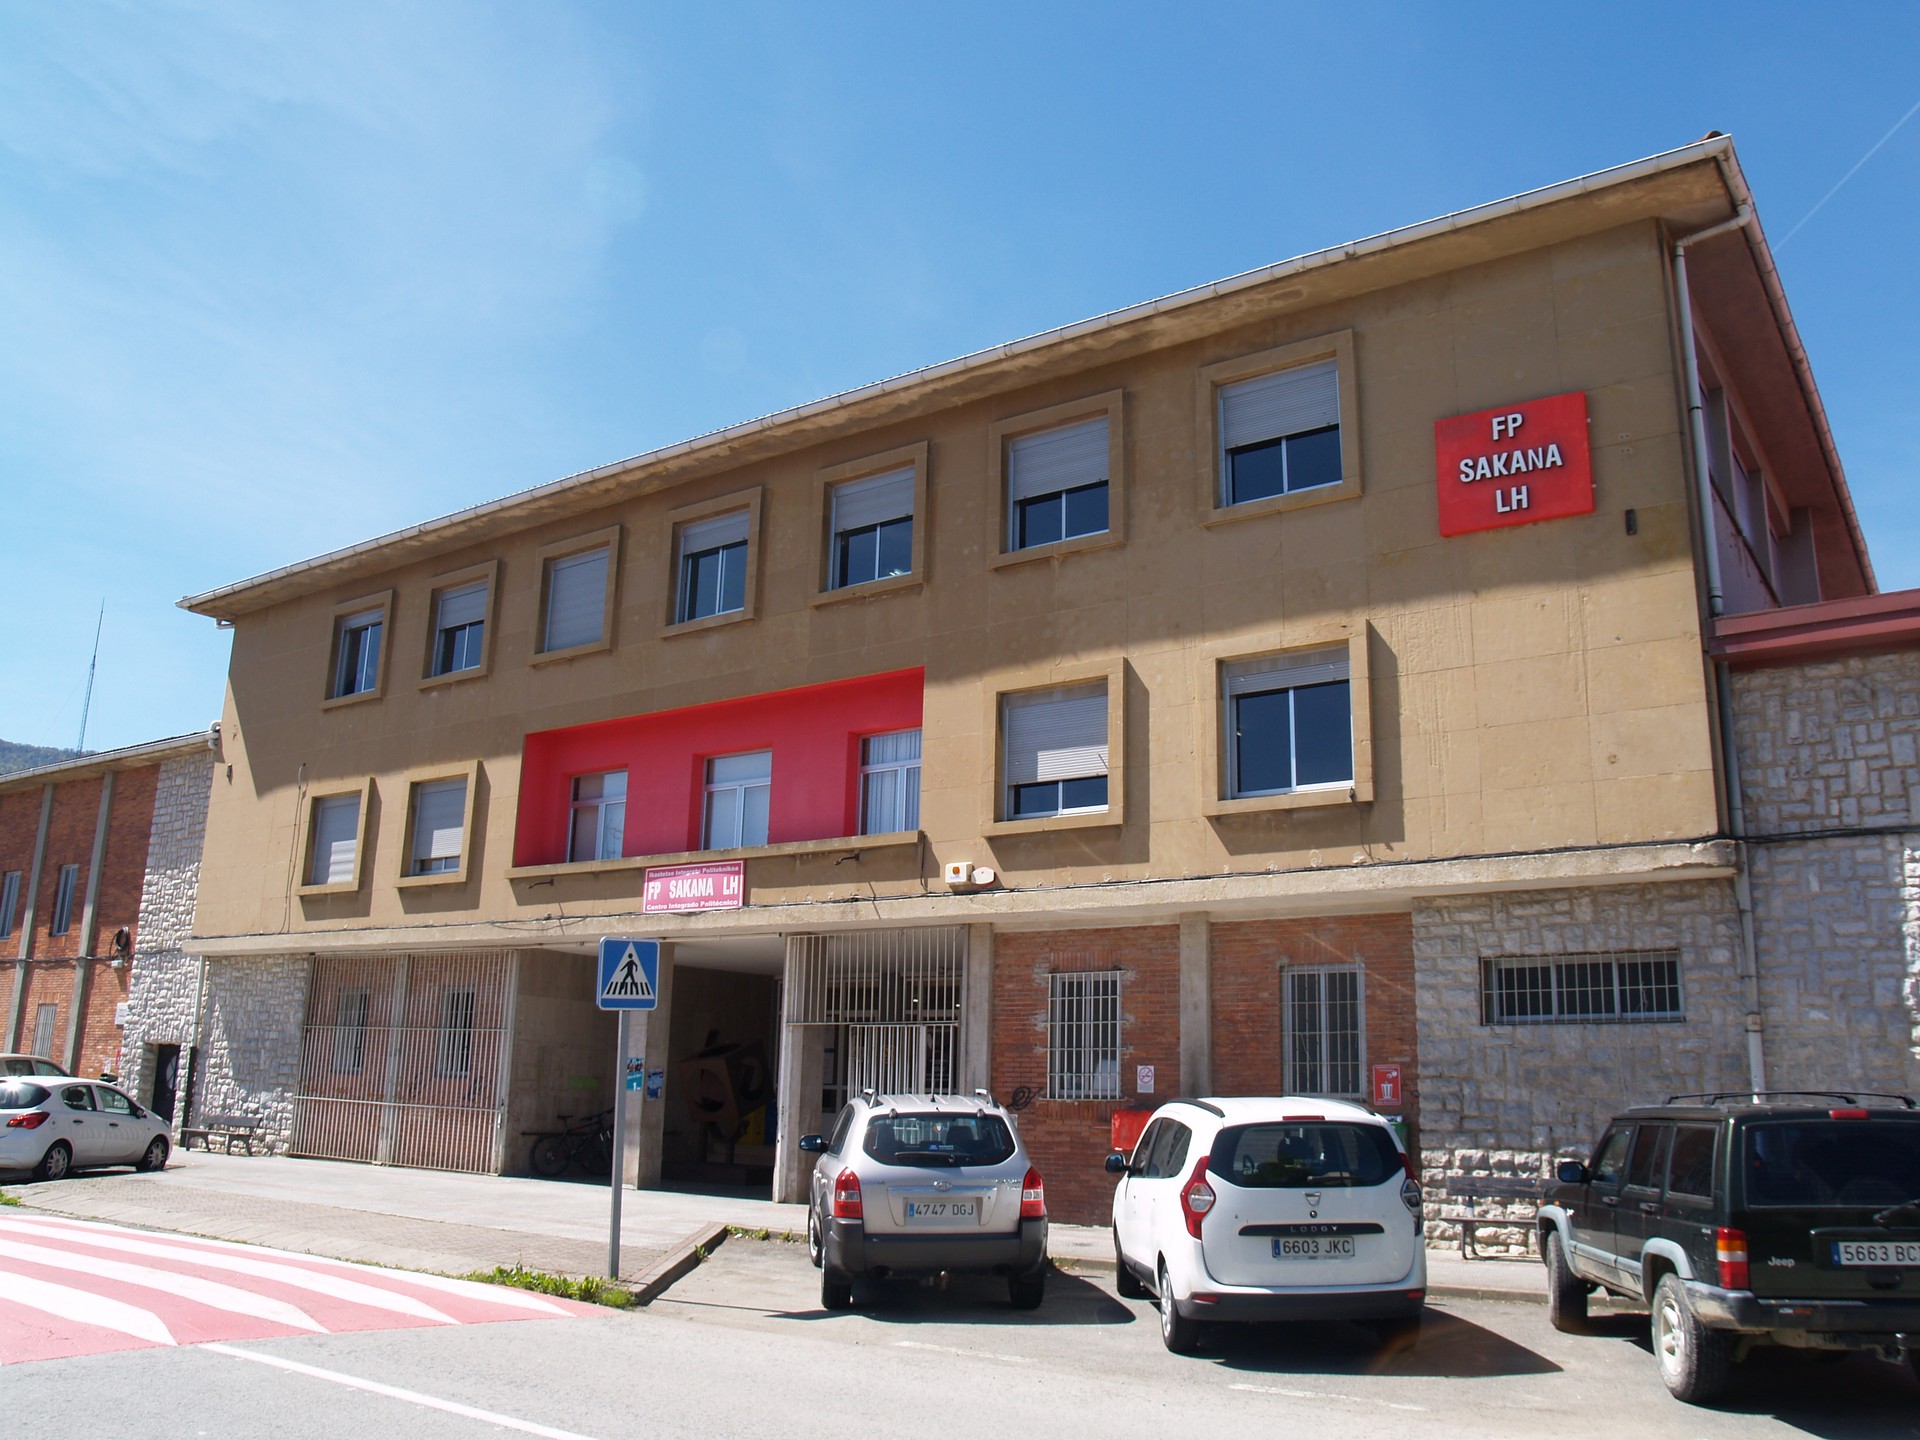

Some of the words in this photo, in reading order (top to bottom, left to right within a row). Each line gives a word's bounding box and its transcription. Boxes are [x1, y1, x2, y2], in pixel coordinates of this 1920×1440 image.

[1492, 413, 1523, 440] FP
[1459, 443, 1563, 483] SAKANA
[1495, 485, 1528, 513] LH
[648, 881, 661, 900] FP
[669, 877, 714, 899] SAKANA
[723, 876, 738, 895] LH
[669, 901, 699, 910] Integrado
[700, 899, 738, 907] Politécnico
[915, 1204, 946, 1216] 4747
[952, 1204, 974, 1216] DGJ
[1283, 1240, 1319, 1254] 6603
[1325, 1240, 1351, 1254] JKC
[1843, 1245, 1889, 1262] 5663
[1894, 1245, 1920, 1262] BC
[1768, 1256, 1795, 1268] Jeep
